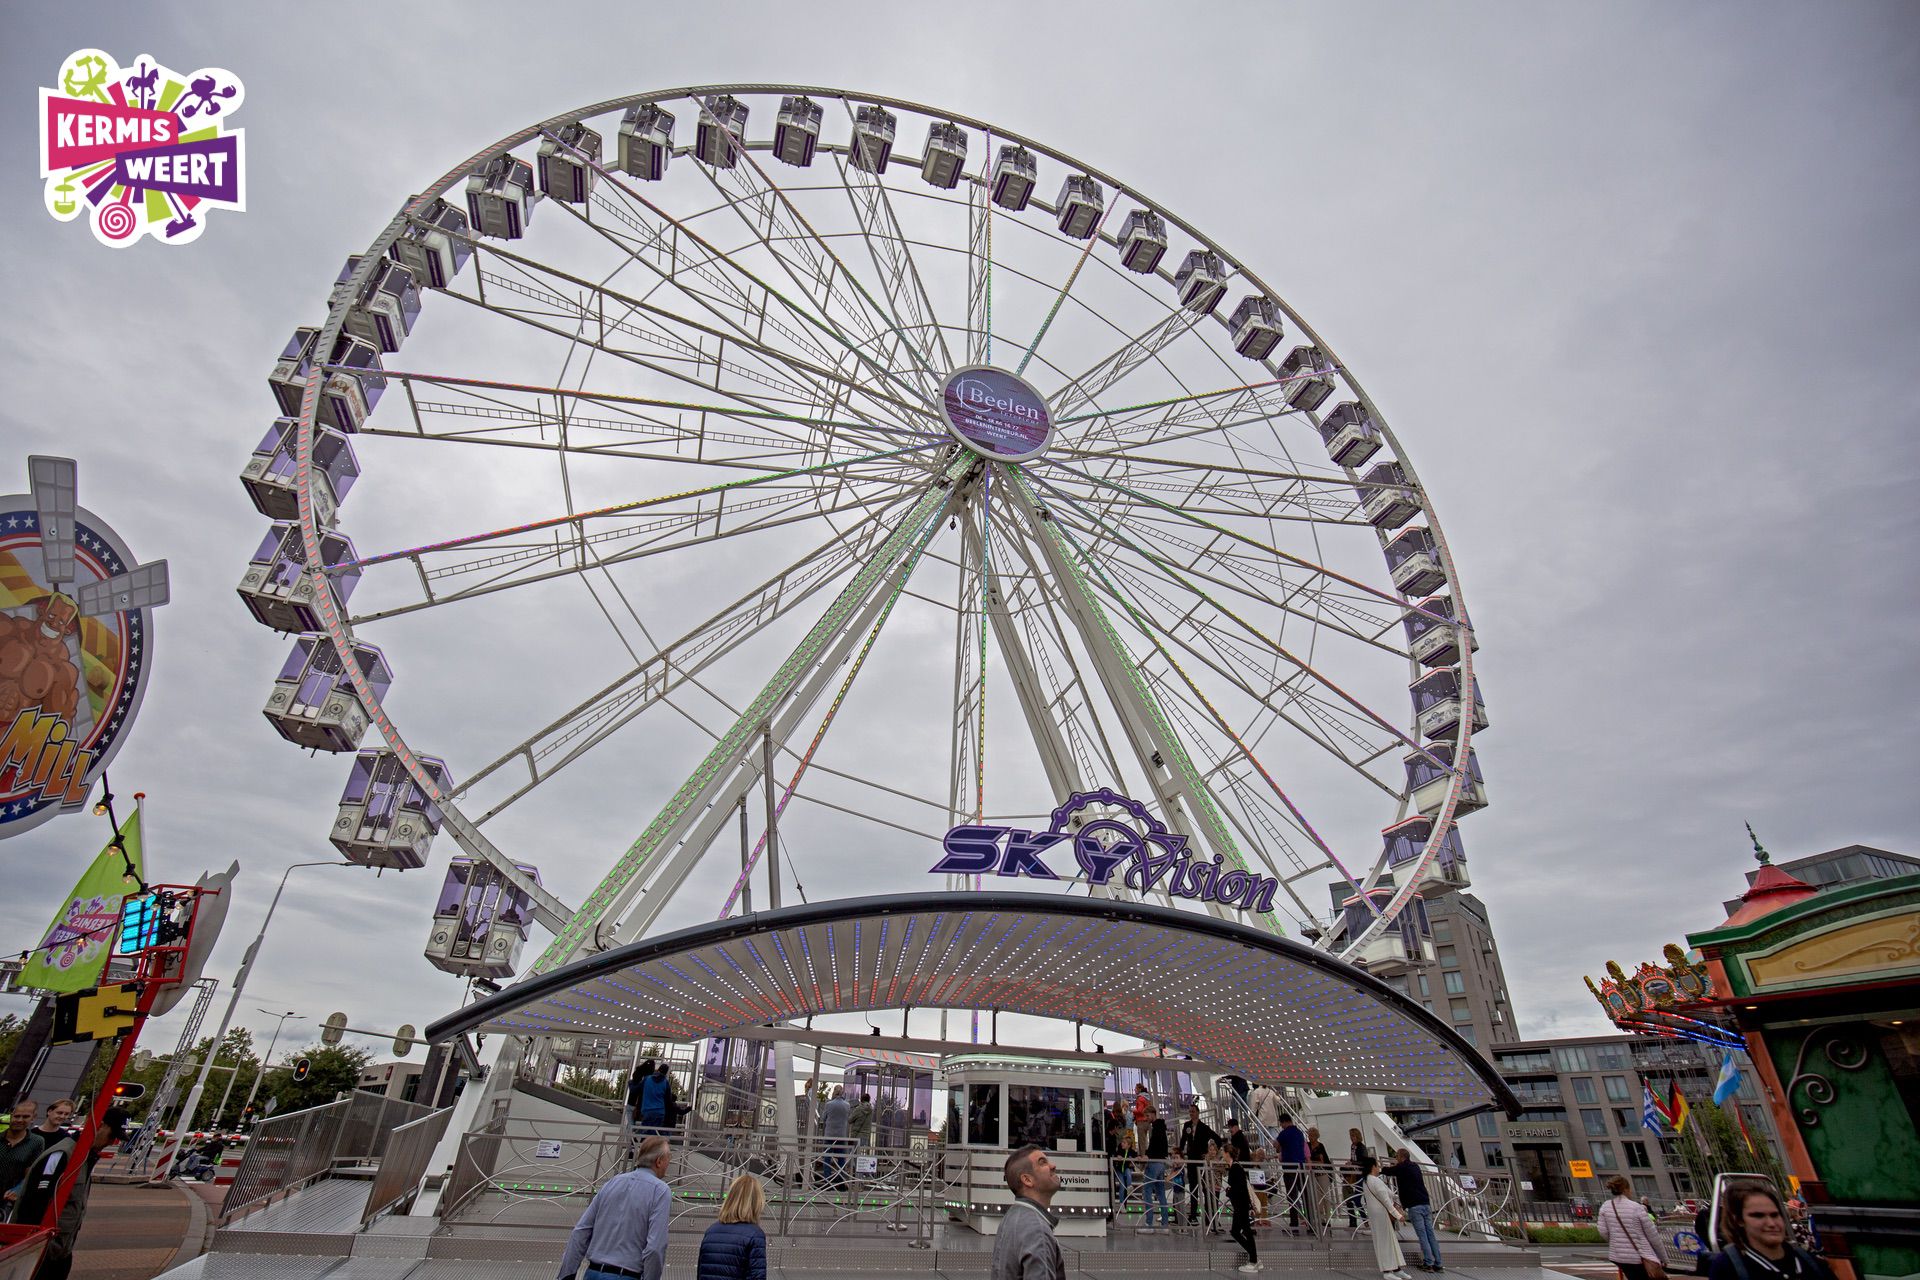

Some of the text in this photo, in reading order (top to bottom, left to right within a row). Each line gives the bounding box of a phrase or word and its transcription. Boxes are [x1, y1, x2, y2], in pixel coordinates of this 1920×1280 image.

[970, 387, 1039, 420] Beelen
[928, 825, 1279, 914] SKY Vision
[1508, 1128, 1521, 1137] DE
[1059, 1176, 1090, 1186] kyvision
